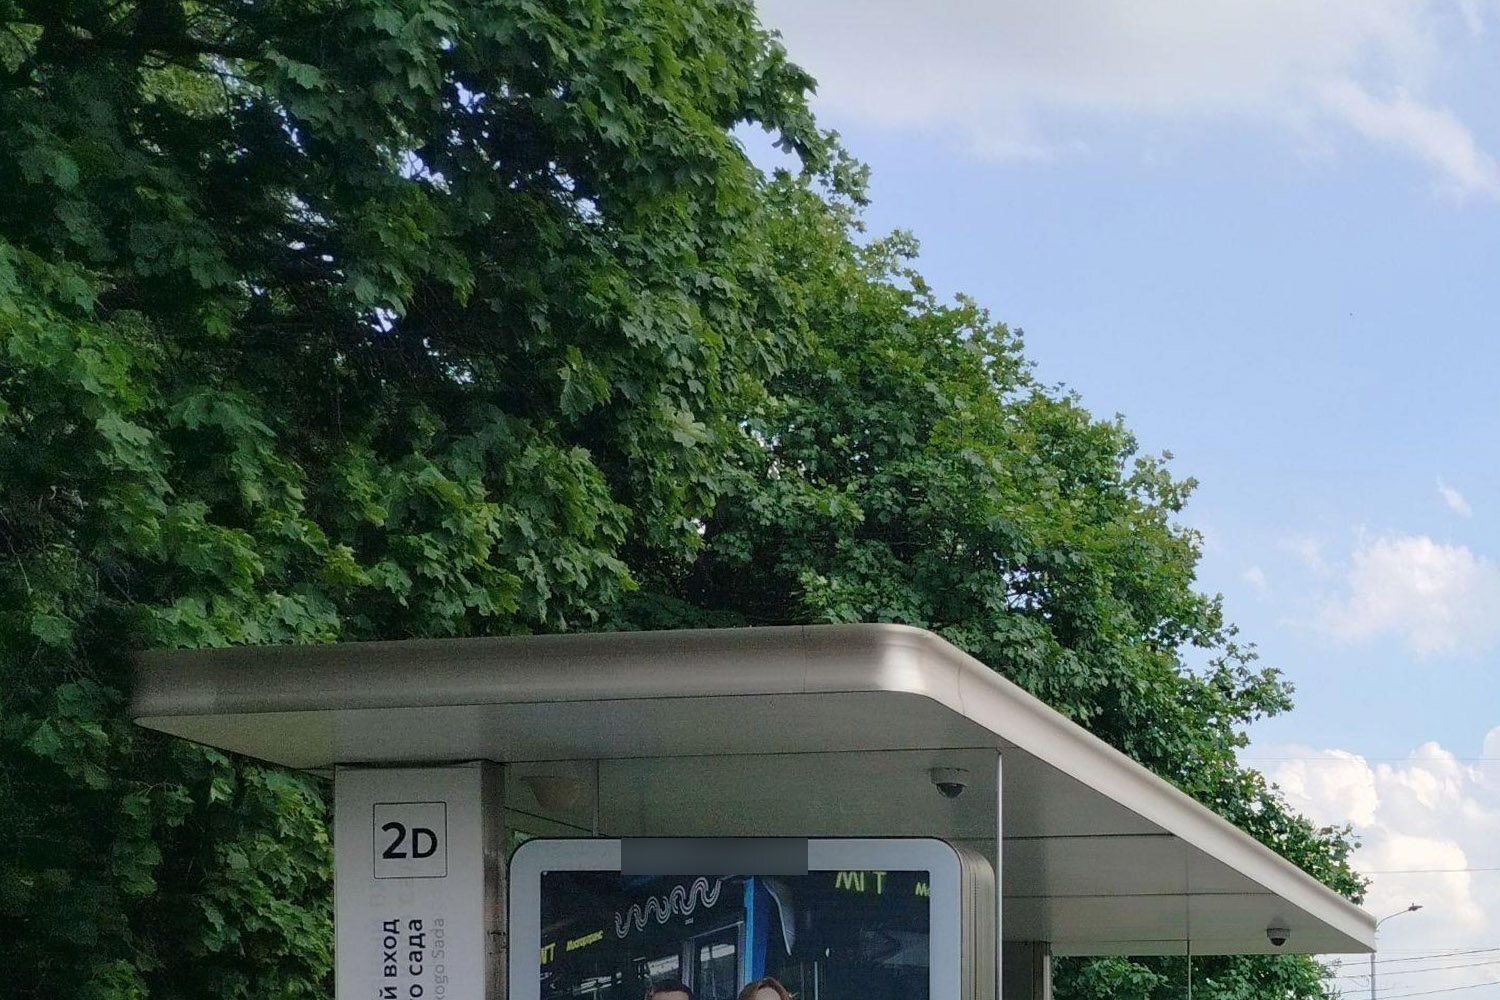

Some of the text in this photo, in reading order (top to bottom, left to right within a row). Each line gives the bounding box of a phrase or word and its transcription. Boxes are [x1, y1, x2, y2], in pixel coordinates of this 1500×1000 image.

[381, 821, 438, 860] 2D
[383, 918, 400, 978] вход
[408, 918, 426, 976] сада
[429, 917, 446, 960] Sada
